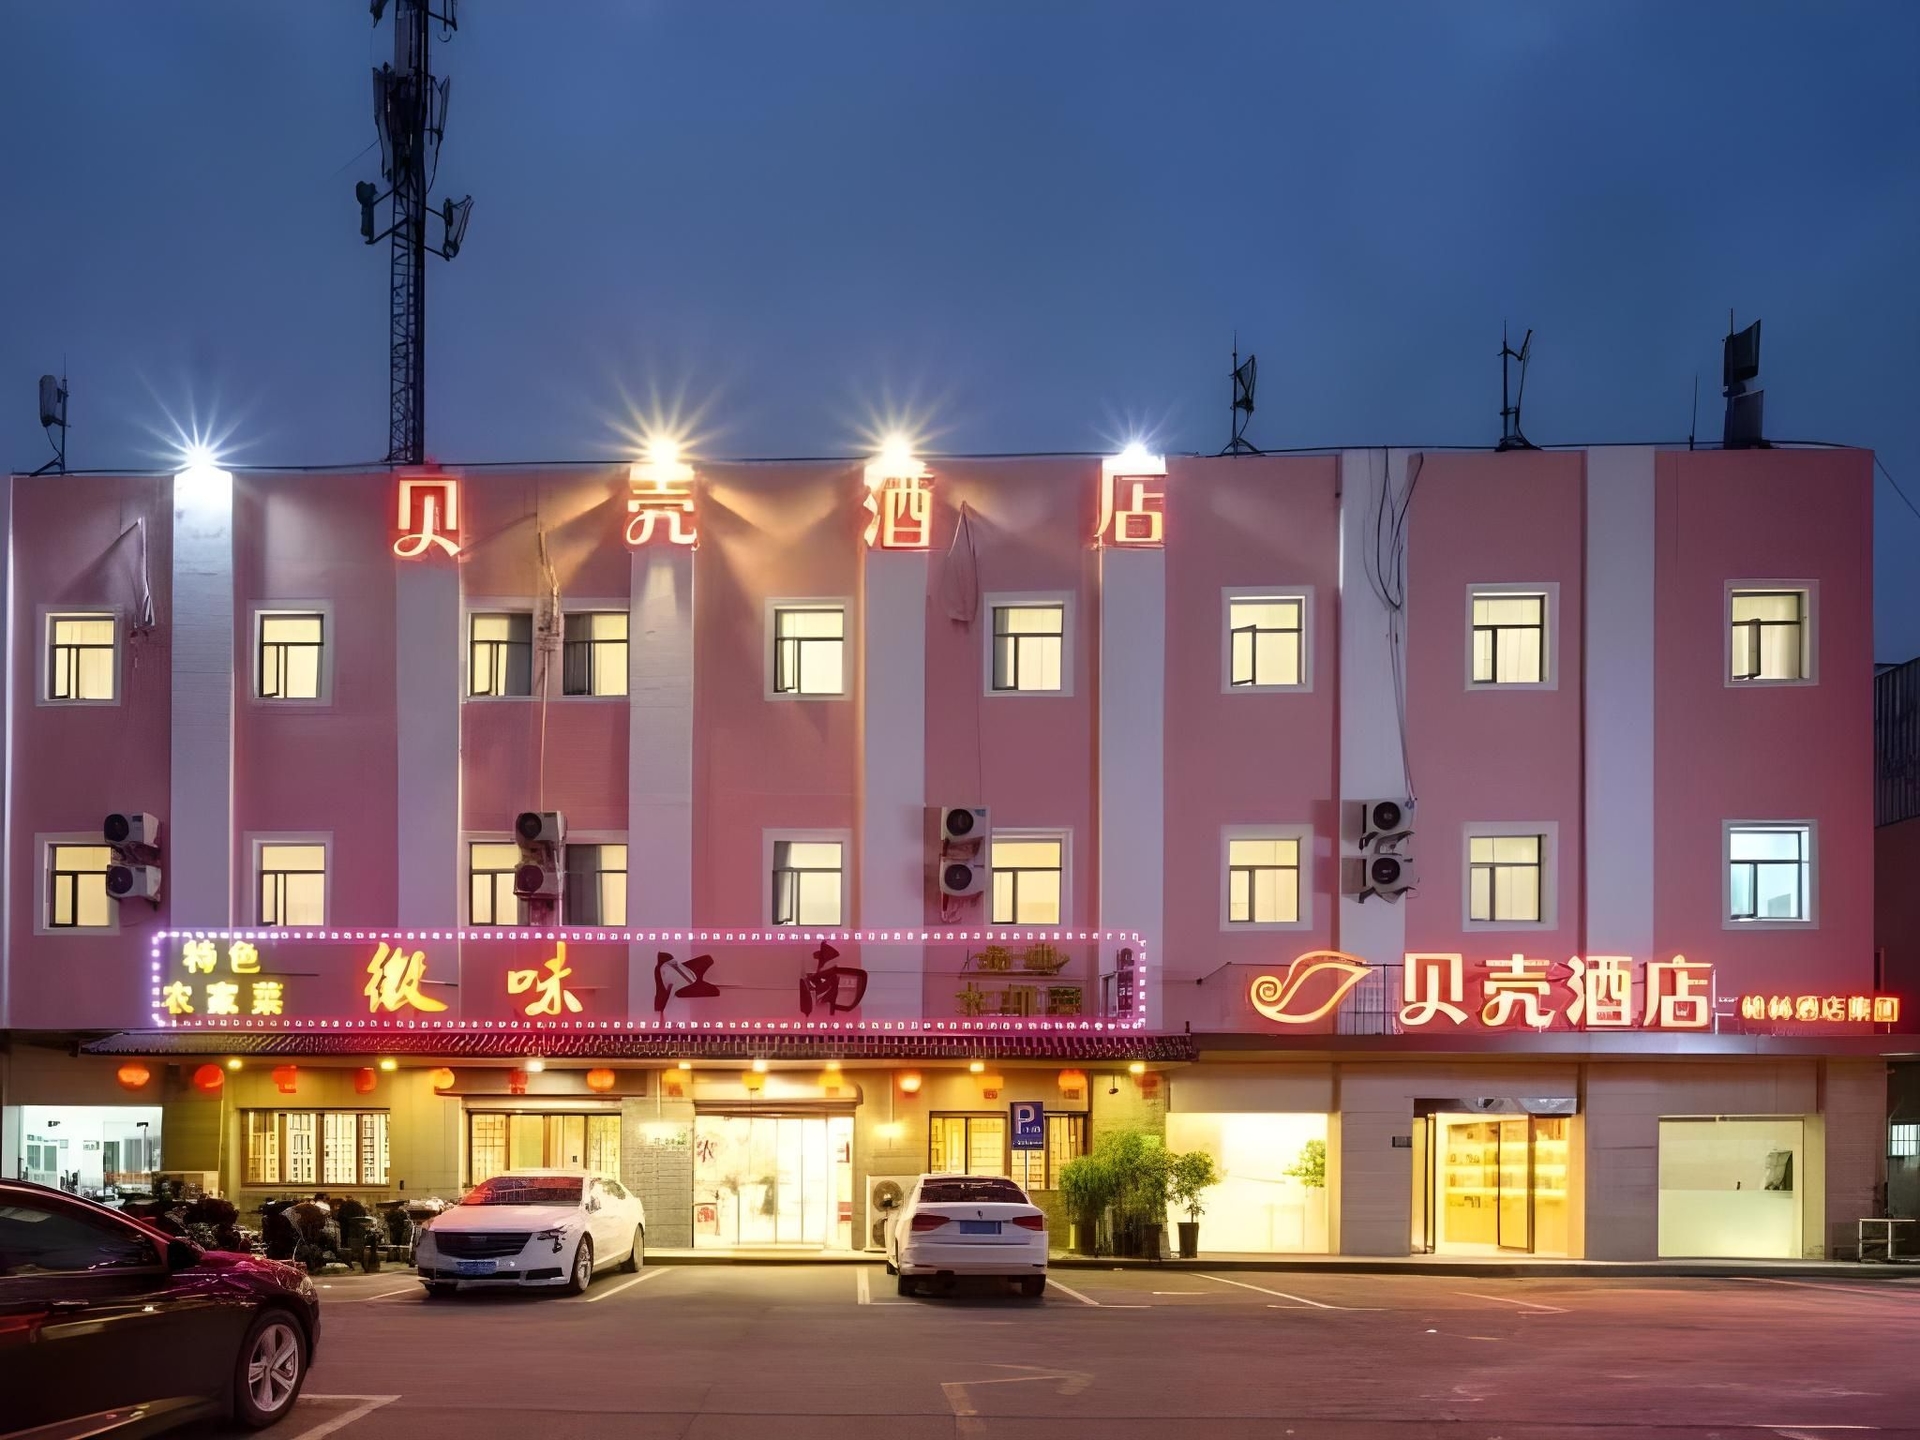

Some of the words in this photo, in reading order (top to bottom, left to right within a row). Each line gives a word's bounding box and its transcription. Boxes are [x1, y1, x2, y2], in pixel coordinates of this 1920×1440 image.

[393, 469, 1168, 558] 贝壳酒店
[182, 939, 261, 974] 特色
[160, 980, 284, 1016] 农家菜
[1399, 952, 1714, 1028] 贝壳酒店
[1015, 1105, 1035, 1134] P
